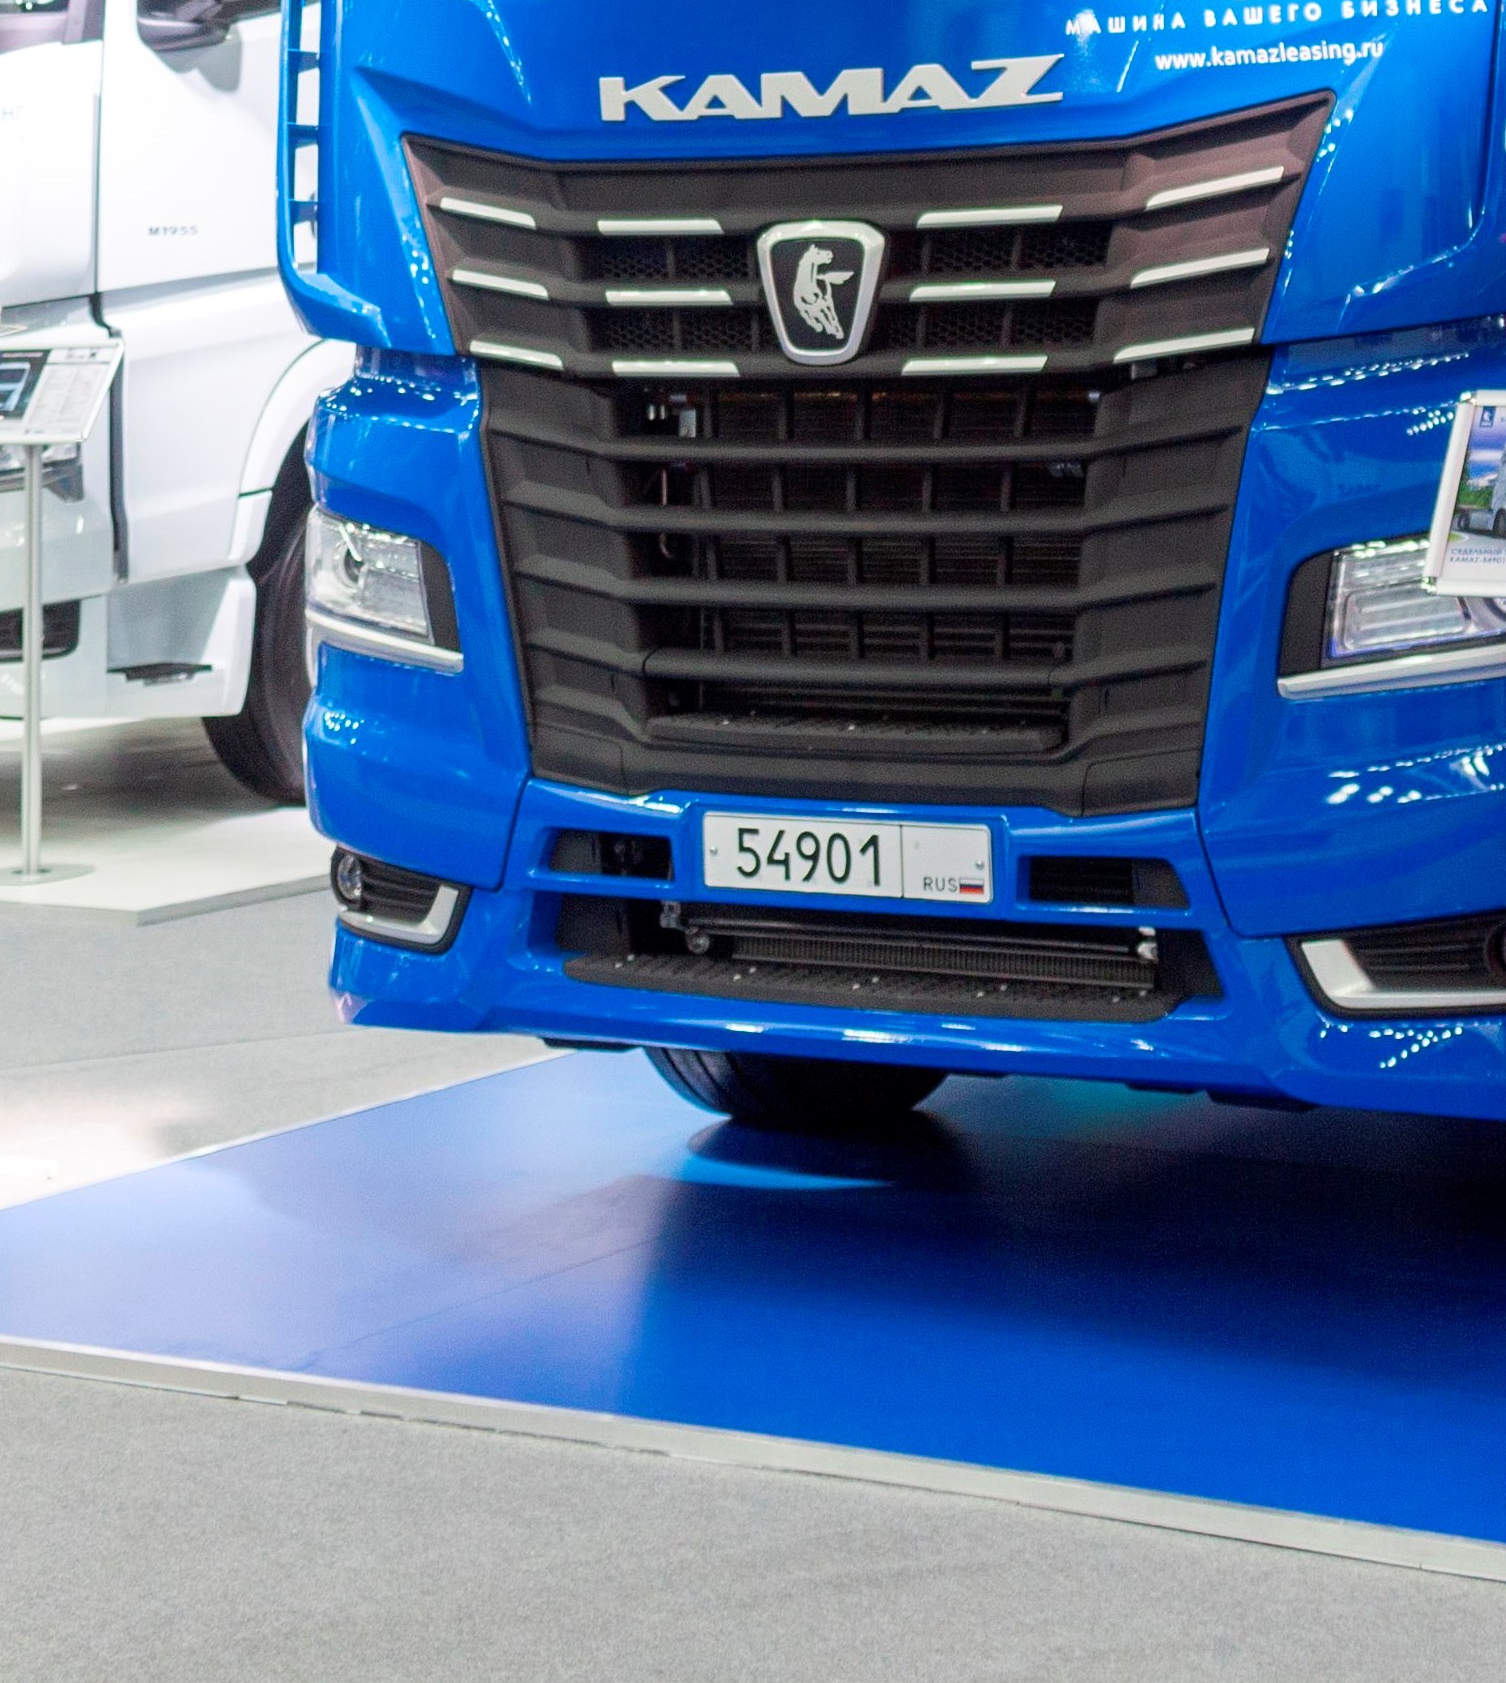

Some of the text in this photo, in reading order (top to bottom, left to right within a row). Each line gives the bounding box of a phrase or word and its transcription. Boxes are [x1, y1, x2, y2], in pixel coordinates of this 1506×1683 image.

[1066, 12, 1186, 36] МАШИНА
[1204, 3, 1322, 28] ВАШЕГО
[1155, 40, 1384, 71] www.kamazleasing.ru
[599, 53, 1065, 122] KAMAZ
[737, 827, 958, 893] 54901 RUS
